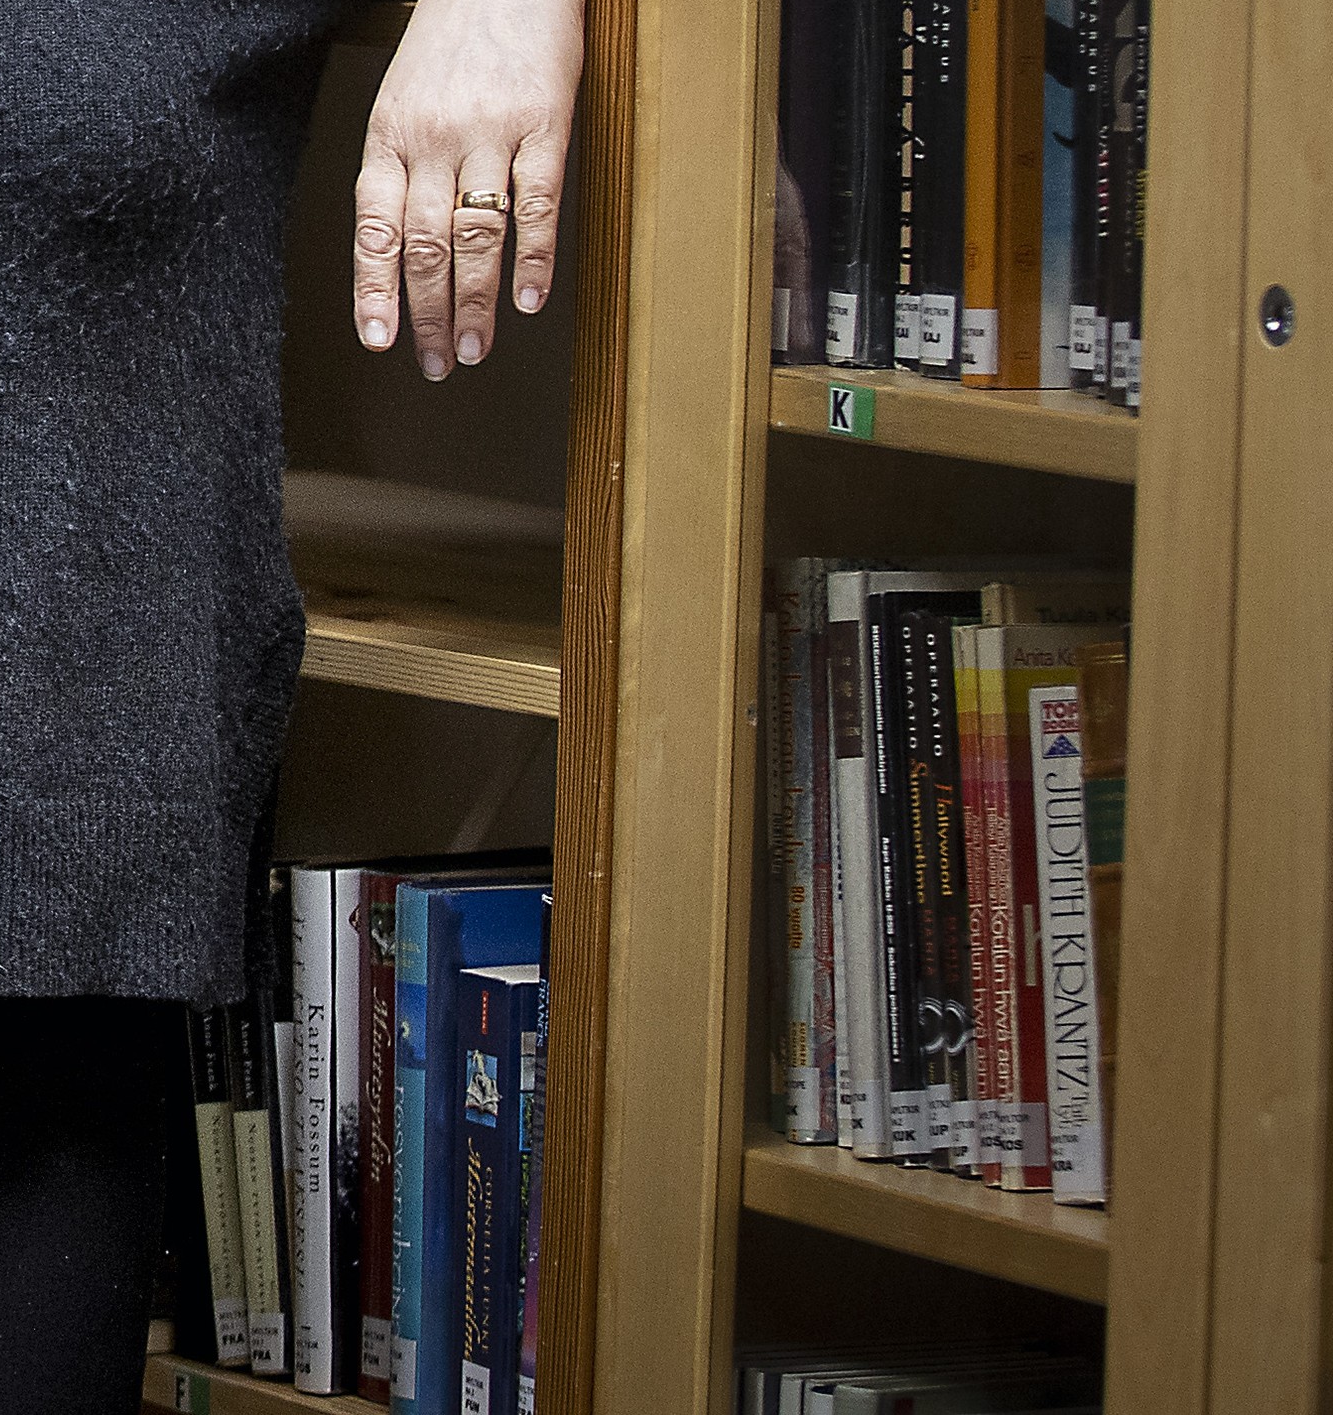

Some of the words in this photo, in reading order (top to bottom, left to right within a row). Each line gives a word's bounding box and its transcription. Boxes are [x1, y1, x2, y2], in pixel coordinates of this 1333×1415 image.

[830, 390, 850, 432] K
[902, 625, 917, 751] OPERAATIO
[926, 631, 943, 759] OPERAATIO
[1013, 648, 1054, 667] Anita
[907, 758, 933, 906] Summertime
[933, 781, 955, 898] Hollywood
[1043, 772, 1086, 918] JUDITH
[787, 906, 805, 950] vuotta
[789, 885, 805, 904] 80
[967, 903, 985, 982] Koulun
[989, 904, 1011, 983] Koulun
[308, 1003, 325, 1081] Karin
[992, 989, 1012, 1043] hyvä
[1051, 933, 1090, 1092] KRANTZ
[367, 986, 393, 1183] Mustesydän
[308, 1097, 325, 1195] Fossum
[482, 1166, 494, 1276] CORNELIA
[479, 1284, 491, 1355] FUNKE
